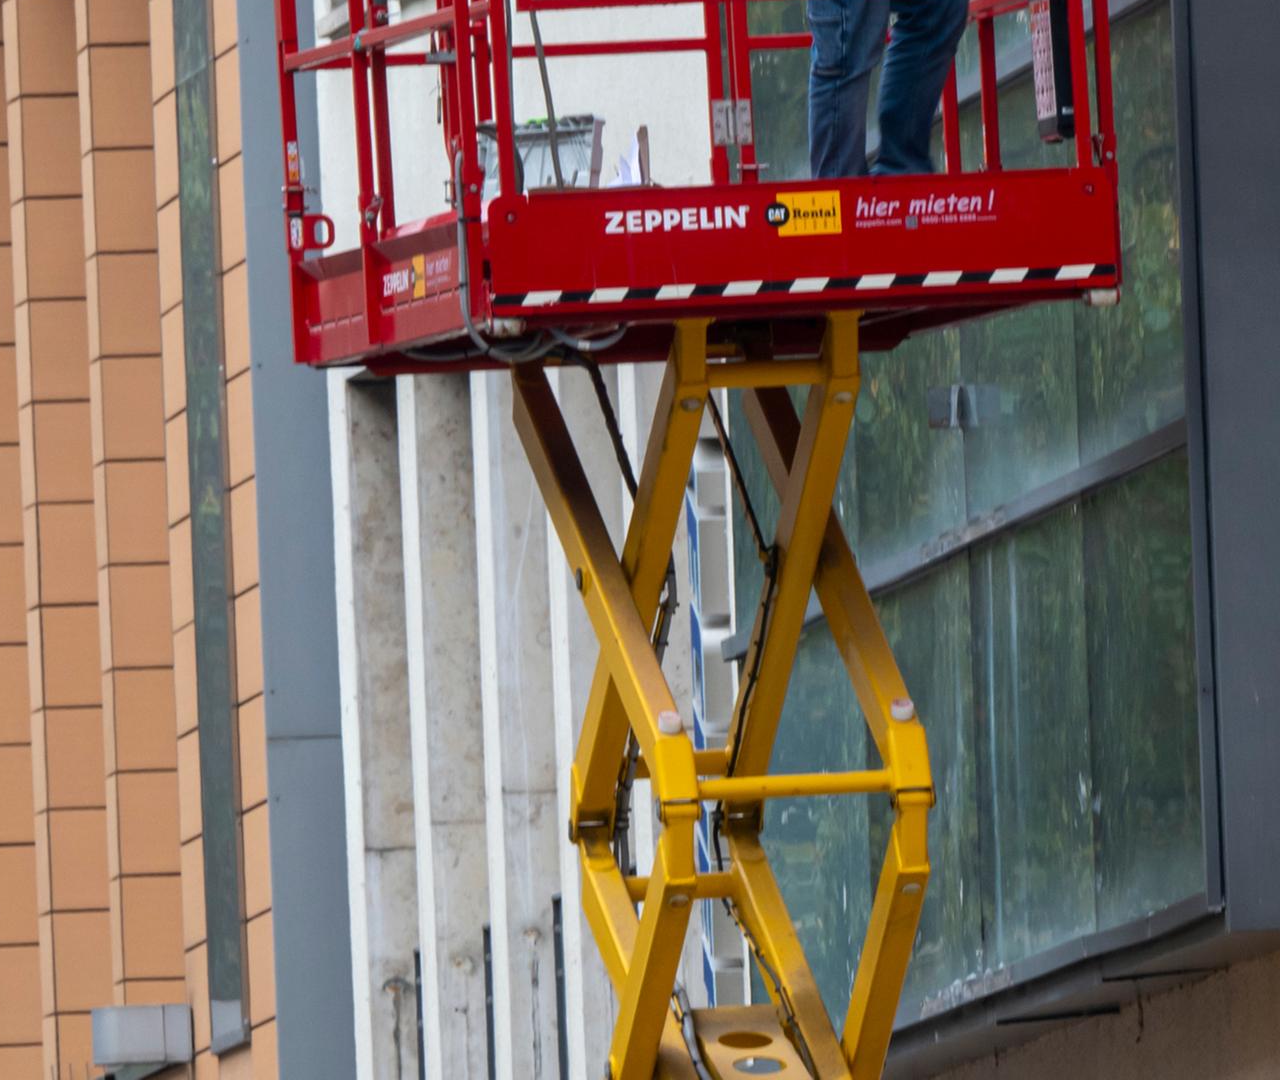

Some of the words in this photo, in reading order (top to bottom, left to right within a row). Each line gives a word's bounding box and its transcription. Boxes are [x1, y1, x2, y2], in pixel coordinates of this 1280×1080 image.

[767, 207, 786, 222] CAT
[792, 206, 836, 219] Rental
[855, 196, 900, 218] hier
[604, 204, 749, 235] ZEPPELIN
